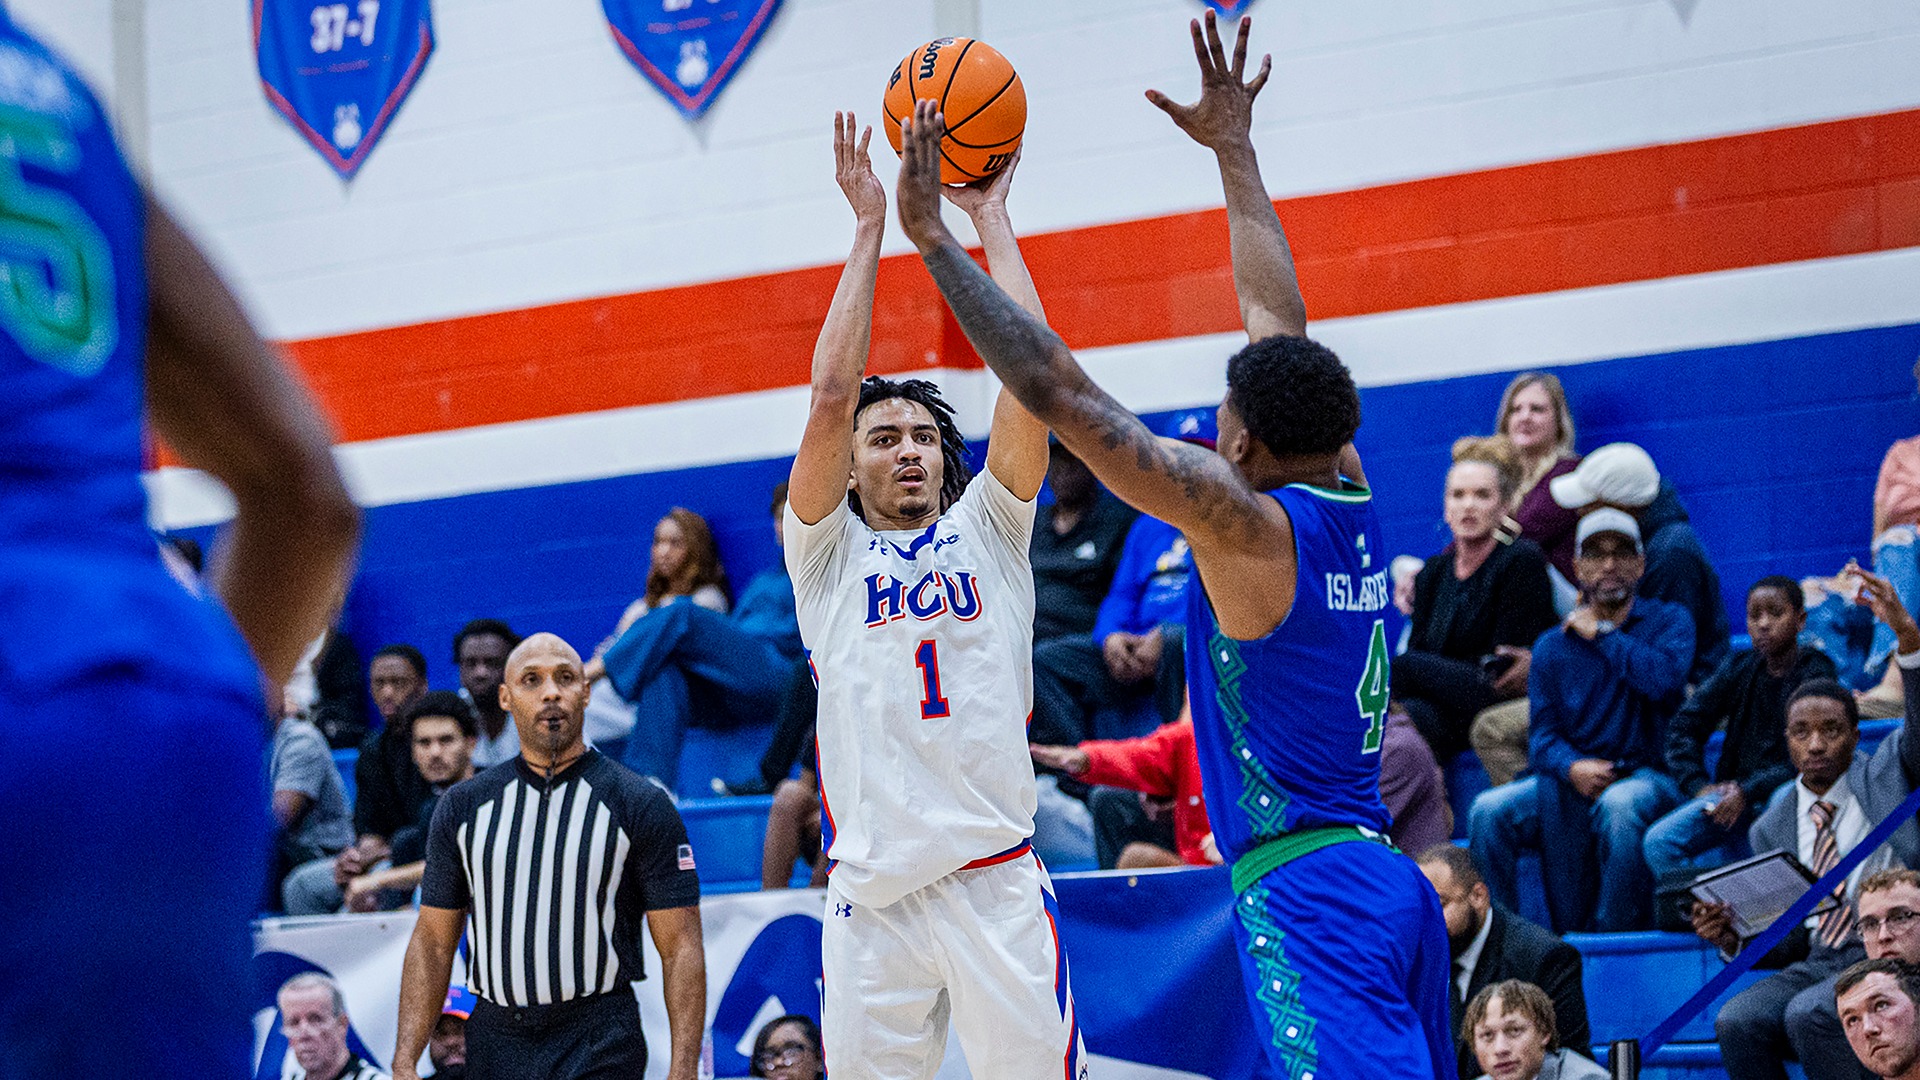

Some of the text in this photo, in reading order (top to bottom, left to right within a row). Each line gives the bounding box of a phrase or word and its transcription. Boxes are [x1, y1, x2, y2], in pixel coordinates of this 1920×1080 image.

[864, 570, 983, 628] HCU
[915, 639, 951, 720] 1
[1355, 618, 1390, 754] 4
